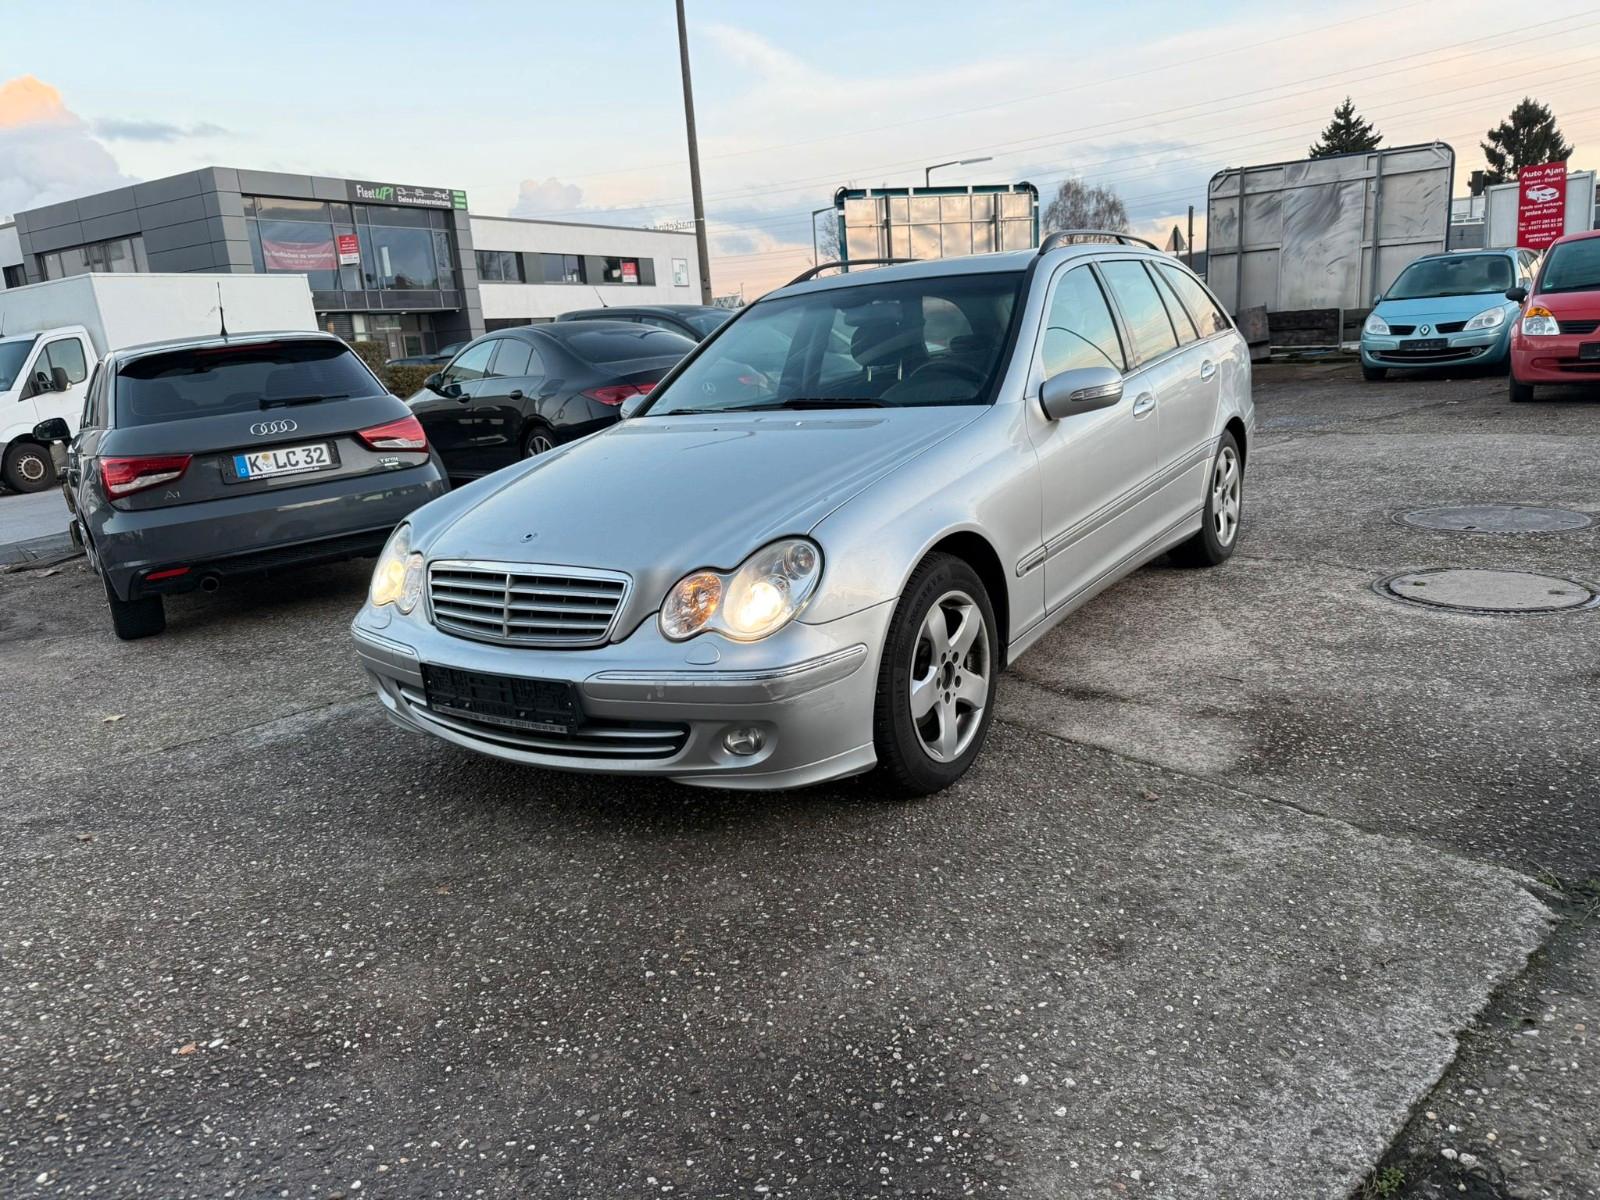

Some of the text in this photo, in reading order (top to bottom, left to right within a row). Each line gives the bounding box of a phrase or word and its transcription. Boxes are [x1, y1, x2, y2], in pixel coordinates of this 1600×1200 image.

[1544, 168, 1564, 176] Ajan
[248, 455, 263, 473] K
[272, 450, 299, 469] LC
[302, 447, 327, 465] 32
[164, 489, 181, 500] A1
